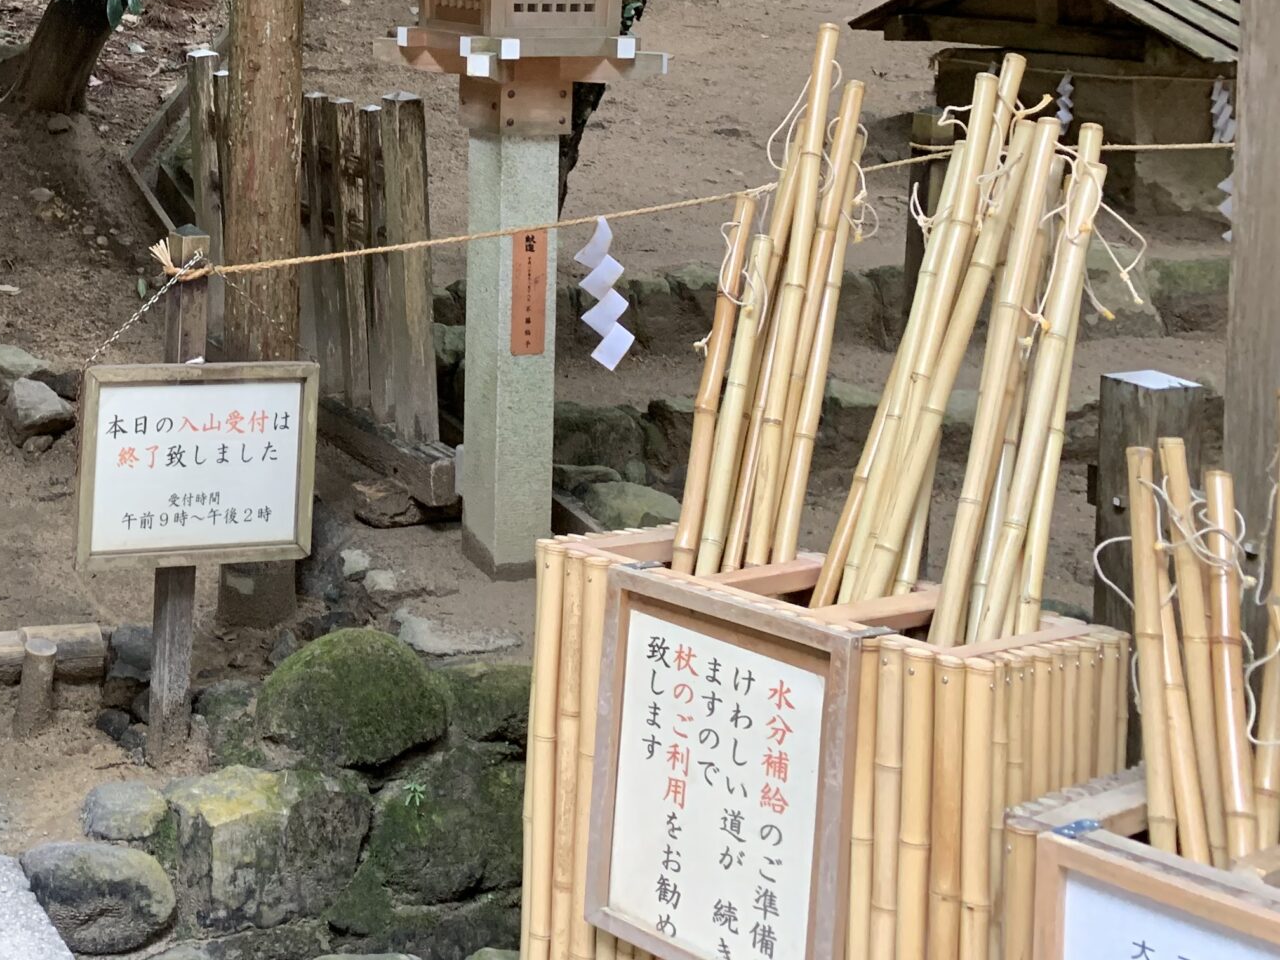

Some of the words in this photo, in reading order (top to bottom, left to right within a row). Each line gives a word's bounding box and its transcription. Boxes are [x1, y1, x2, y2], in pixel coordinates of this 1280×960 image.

[106, 409, 291, 440] 本日の入山受付は
[117, 441, 279, 469] 終了致しました
[168, 491, 221, 508] 受付時間
[641, 635, 671, 760] 致します
[697, 657, 724, 787] ますので
[655, 643, 699, 938] 杖のご利用をお勧め
[748, 679, 796, 960] 水分補給のご準備
